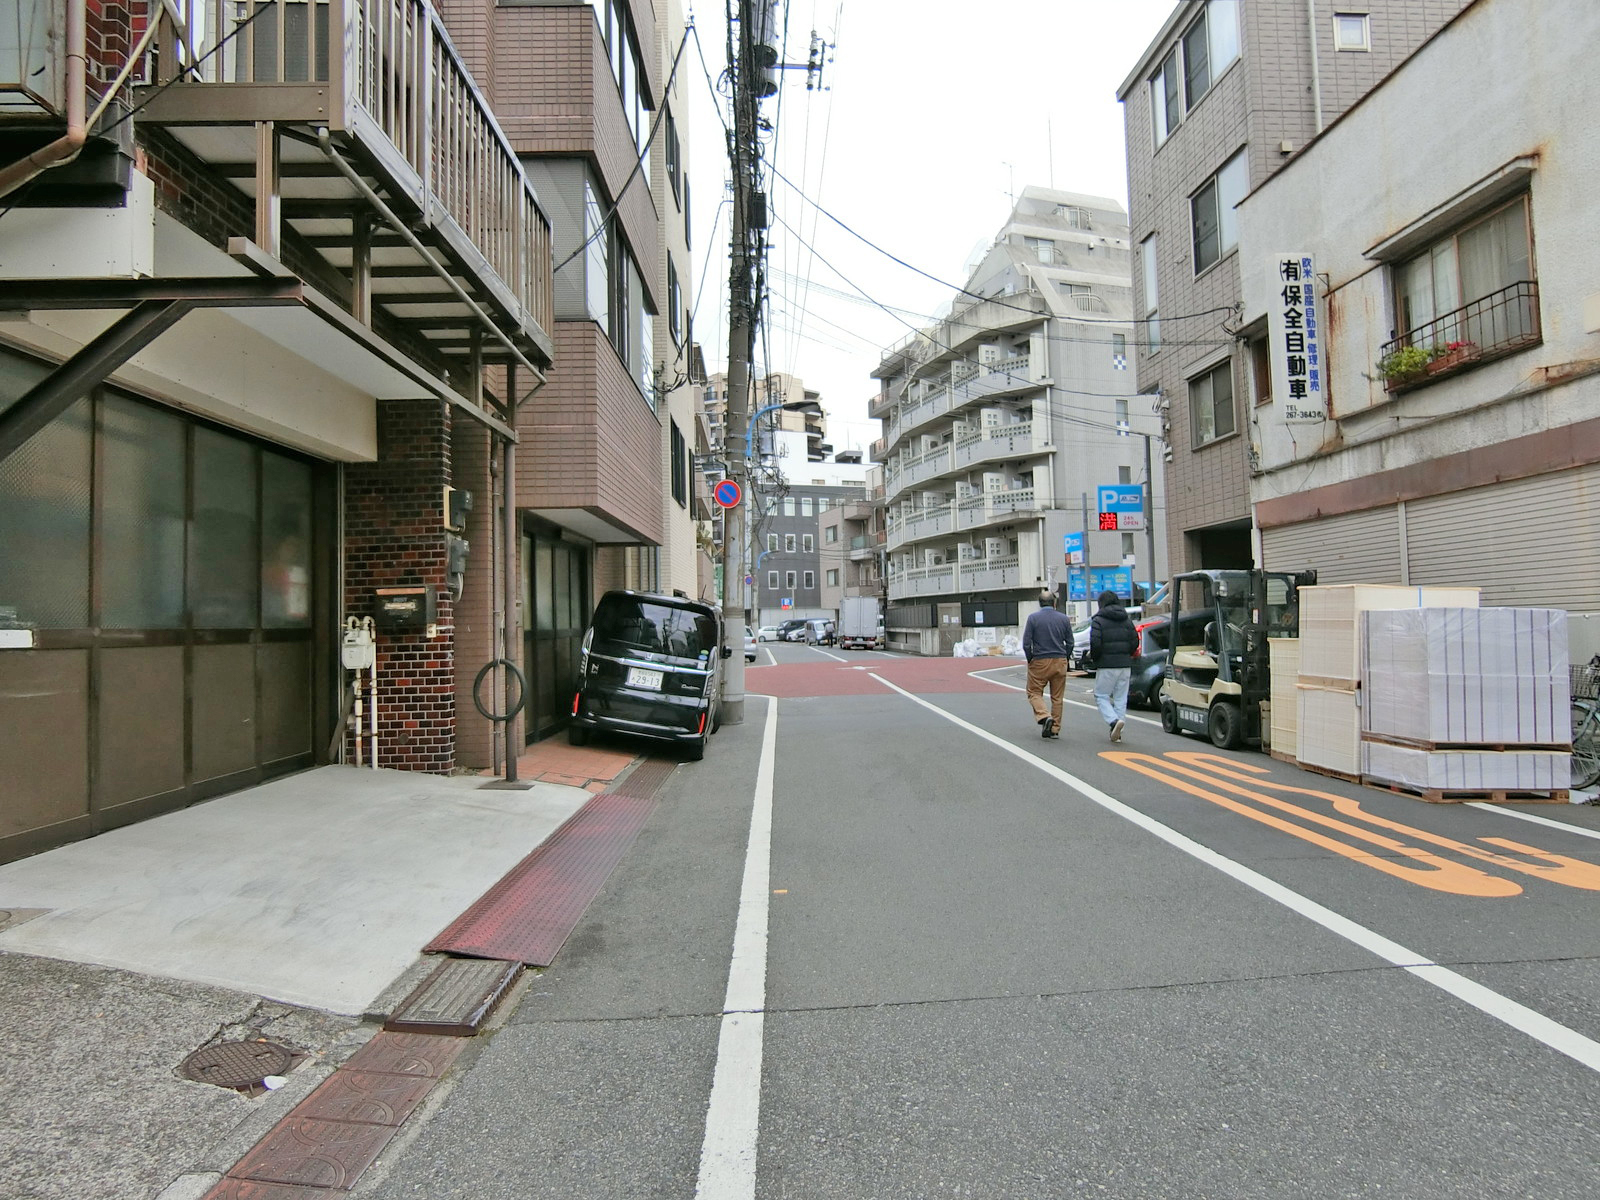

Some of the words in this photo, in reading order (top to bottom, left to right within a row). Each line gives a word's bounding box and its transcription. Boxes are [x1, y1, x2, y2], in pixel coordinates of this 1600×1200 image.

[1101, 490, 1118, 513] P
[1100, 513, 1117, 530] 満
[1065, 537, 1071, 553] P
